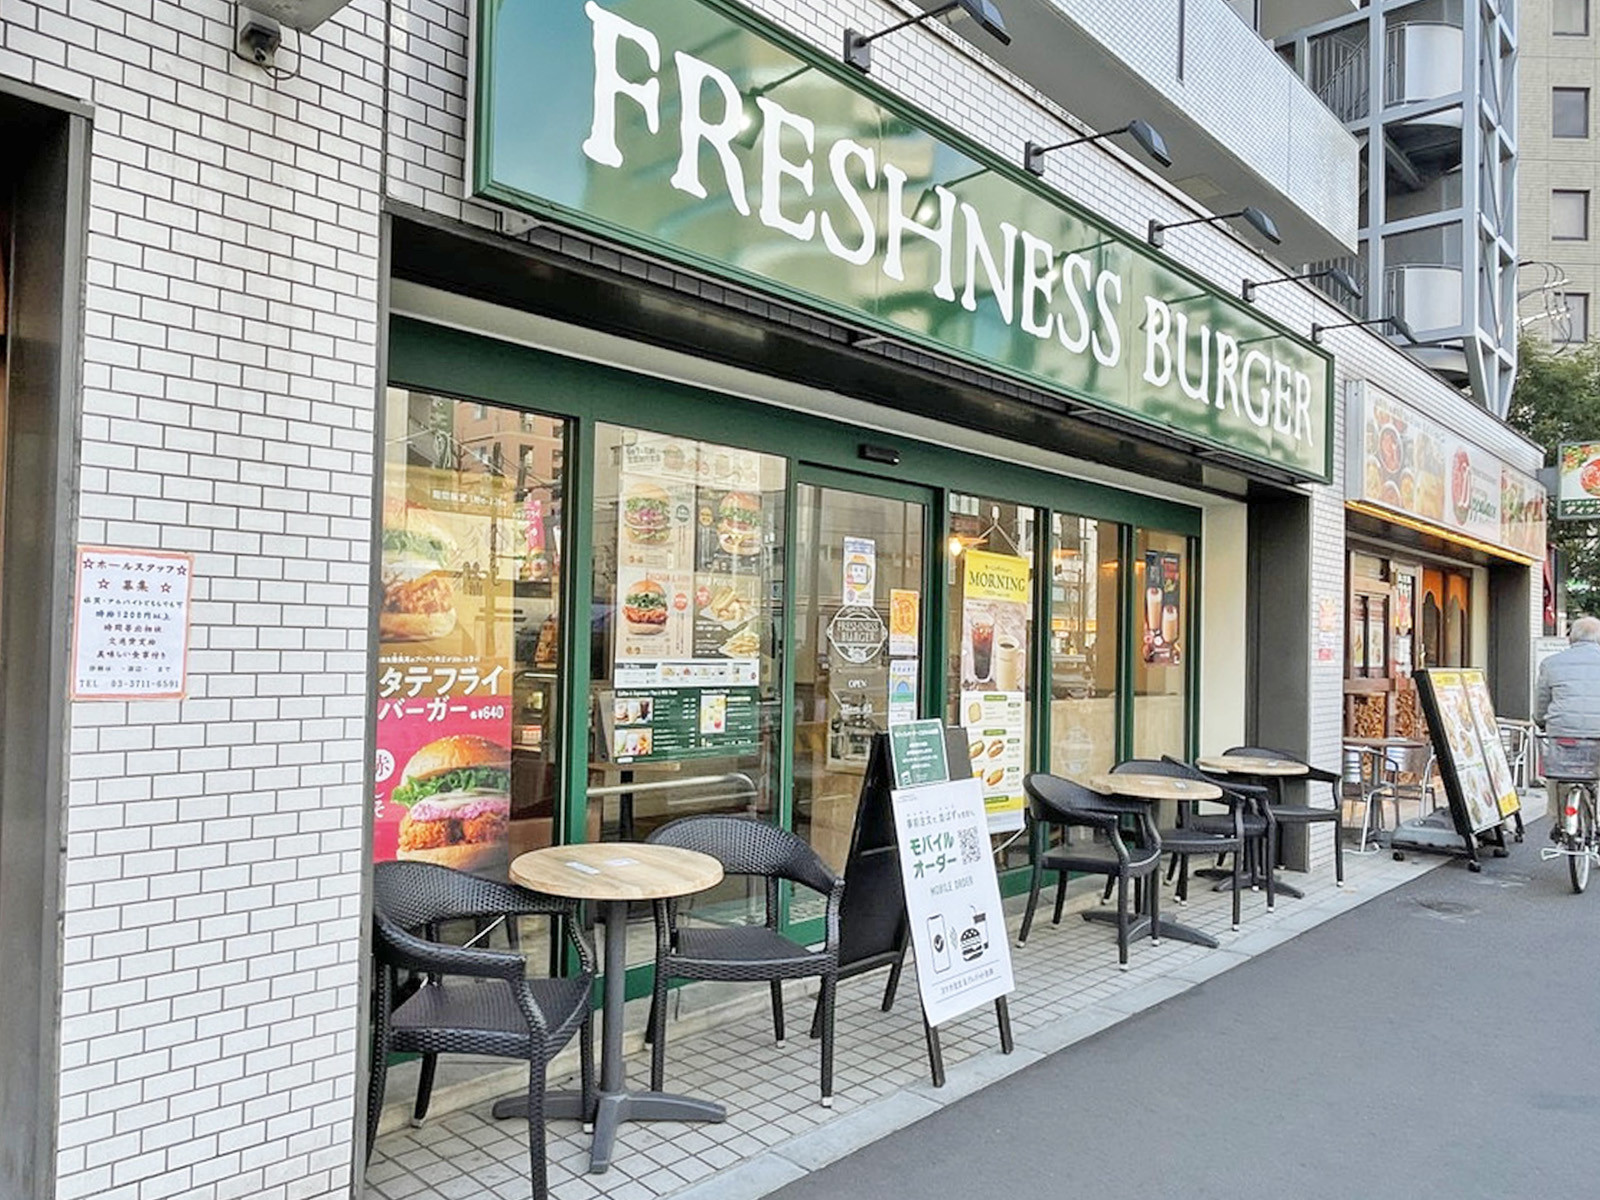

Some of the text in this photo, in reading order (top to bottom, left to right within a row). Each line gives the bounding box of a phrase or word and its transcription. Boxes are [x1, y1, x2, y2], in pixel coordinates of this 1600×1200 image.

[582, 0, 1313, 447] FRESHNESS BURGER
[968, 570, 1025, 592] MORNING
[80, 680, 98, 688] TEL
[379, 665, 504, 698] タテフライ
[377, 694, 468, 722] バーガー
[909, 831, 955, 856] モバイル
[913, 853, 957, 878] オーダー
